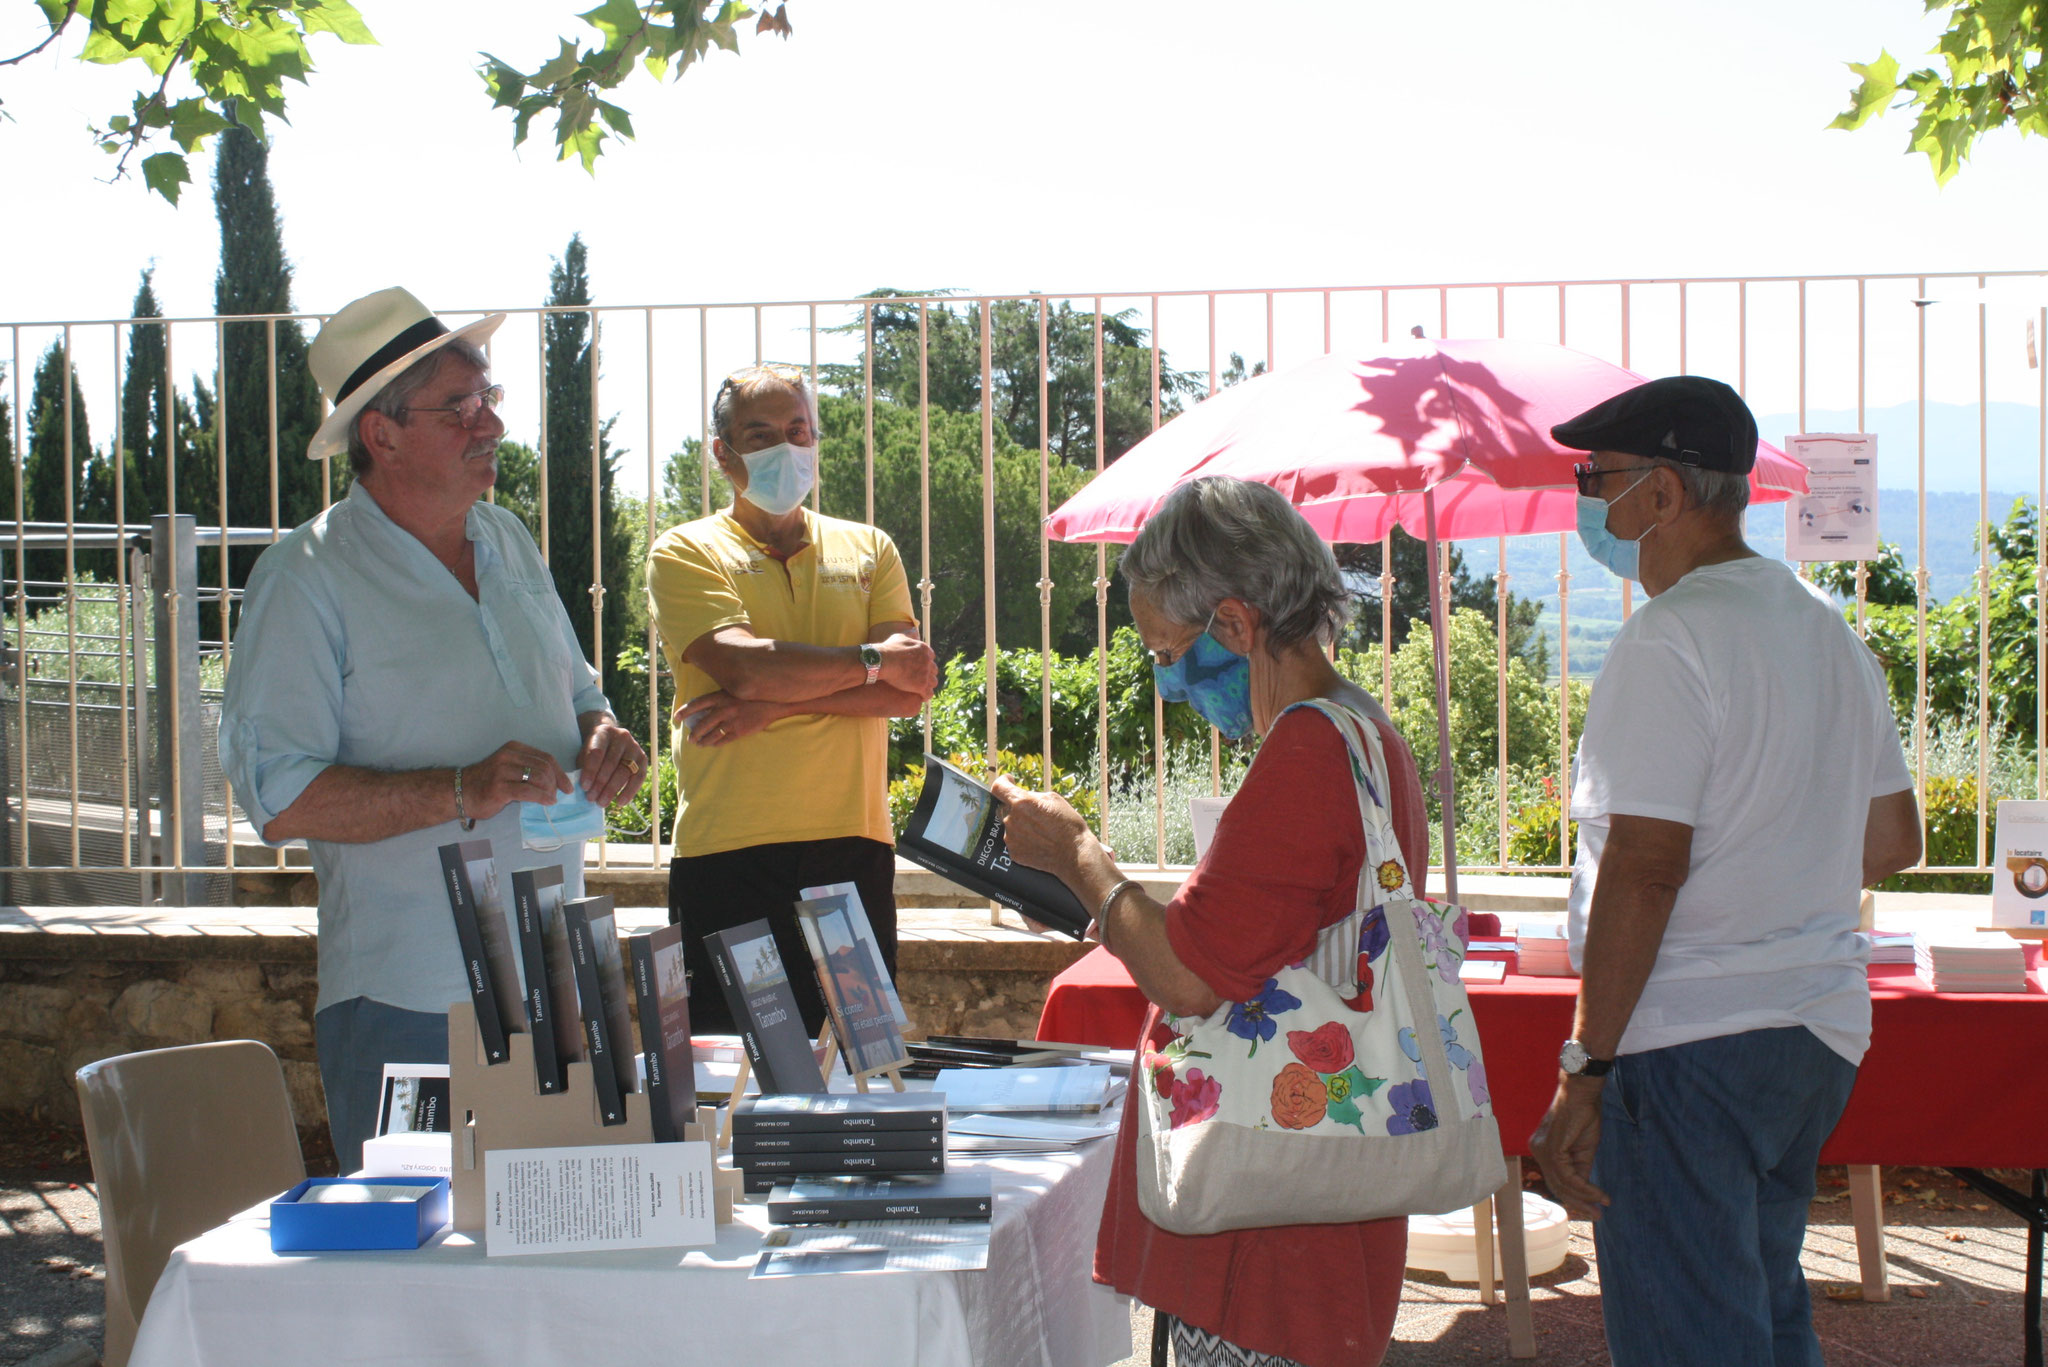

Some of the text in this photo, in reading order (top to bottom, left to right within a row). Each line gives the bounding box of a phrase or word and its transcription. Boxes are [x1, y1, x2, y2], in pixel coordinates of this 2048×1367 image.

[977, 838, 996, 867] DIEGO
[2014, 848, 2042, 857] locataire
[994, 891, 1024, 911] Tanambo
[472, 959, 485, 994] Tanambo
[533, 988, 543, 1023] Tanambo
[834, 1002, 864, 1018] Si conter
[756, 1006, 788, 1029] Tanambo
[589, 1020, 603, 1055] Tanambo
[746, 1032, 760, 1062] Tanambo
[651, 1052, 661, 1087] Tanambo
[425, 1095, 437, 1132] anambo
[843, 1118, 876, 1126] Tanambo
[843, 1138, 876, 1146] Tanambo
[414, 1164, 437, 1172] Galaxy
[843, 1158, 876, 1166] Tanambo
[885, 1205, 920, 1214] Tanambo
